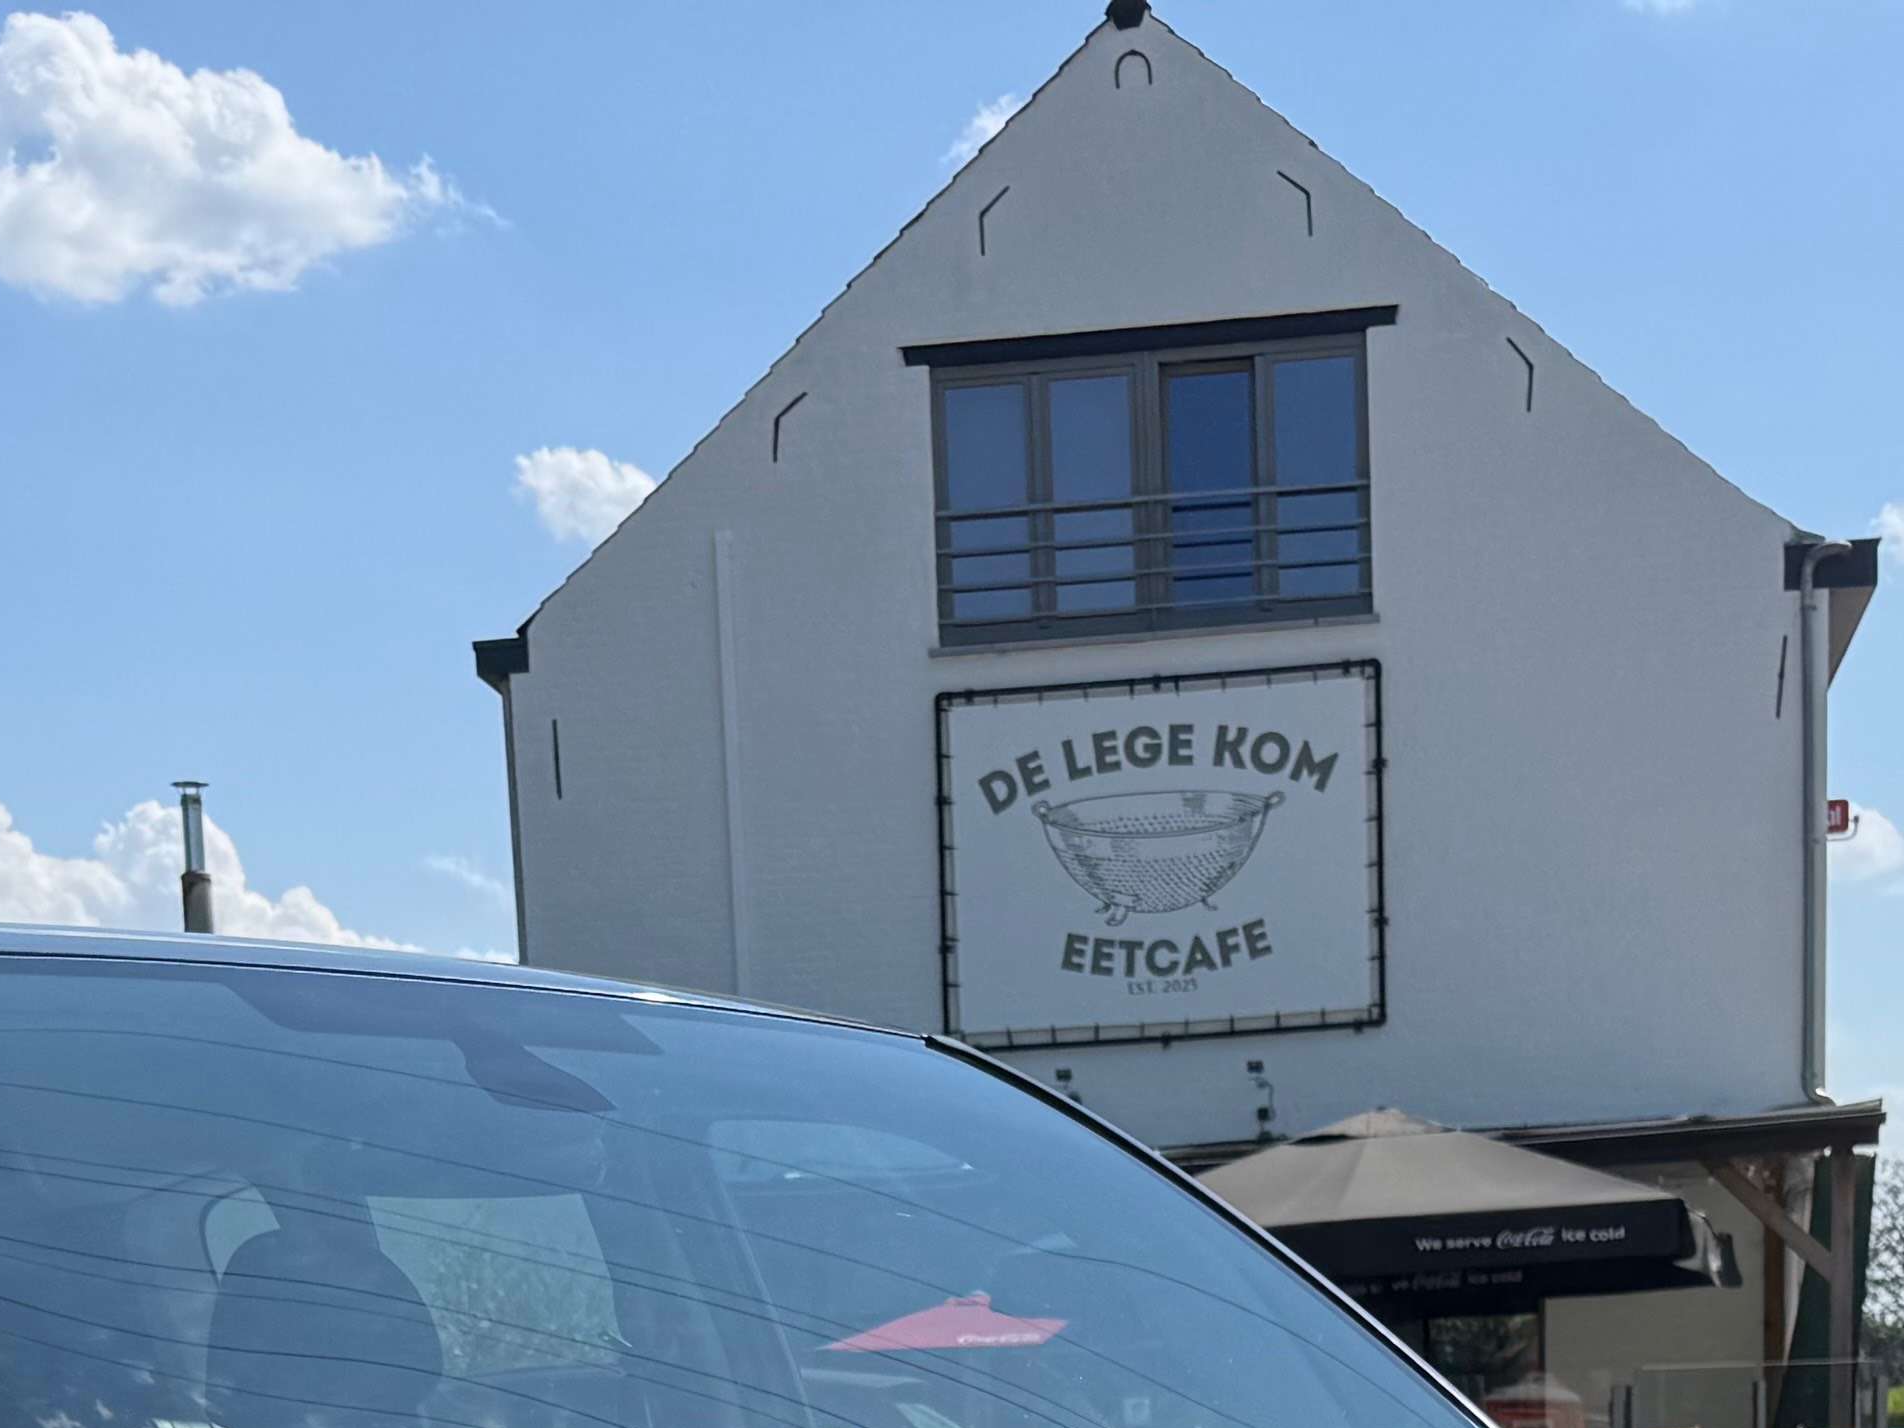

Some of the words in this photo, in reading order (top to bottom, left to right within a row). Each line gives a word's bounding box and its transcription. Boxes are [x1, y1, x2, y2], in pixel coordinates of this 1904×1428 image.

[978, 750, 1052, 815] DE
[1061, 724, 1194, 782] LEGE
[1212, 724, 1339, 793] KOM
[1061, 918, 1273, 978] EETCAFE
[1415, 1237, 1442, 1251] We
[1446, 1237, 1492, 1249] serve
[1589, 1226, 1626, 1242] cold
